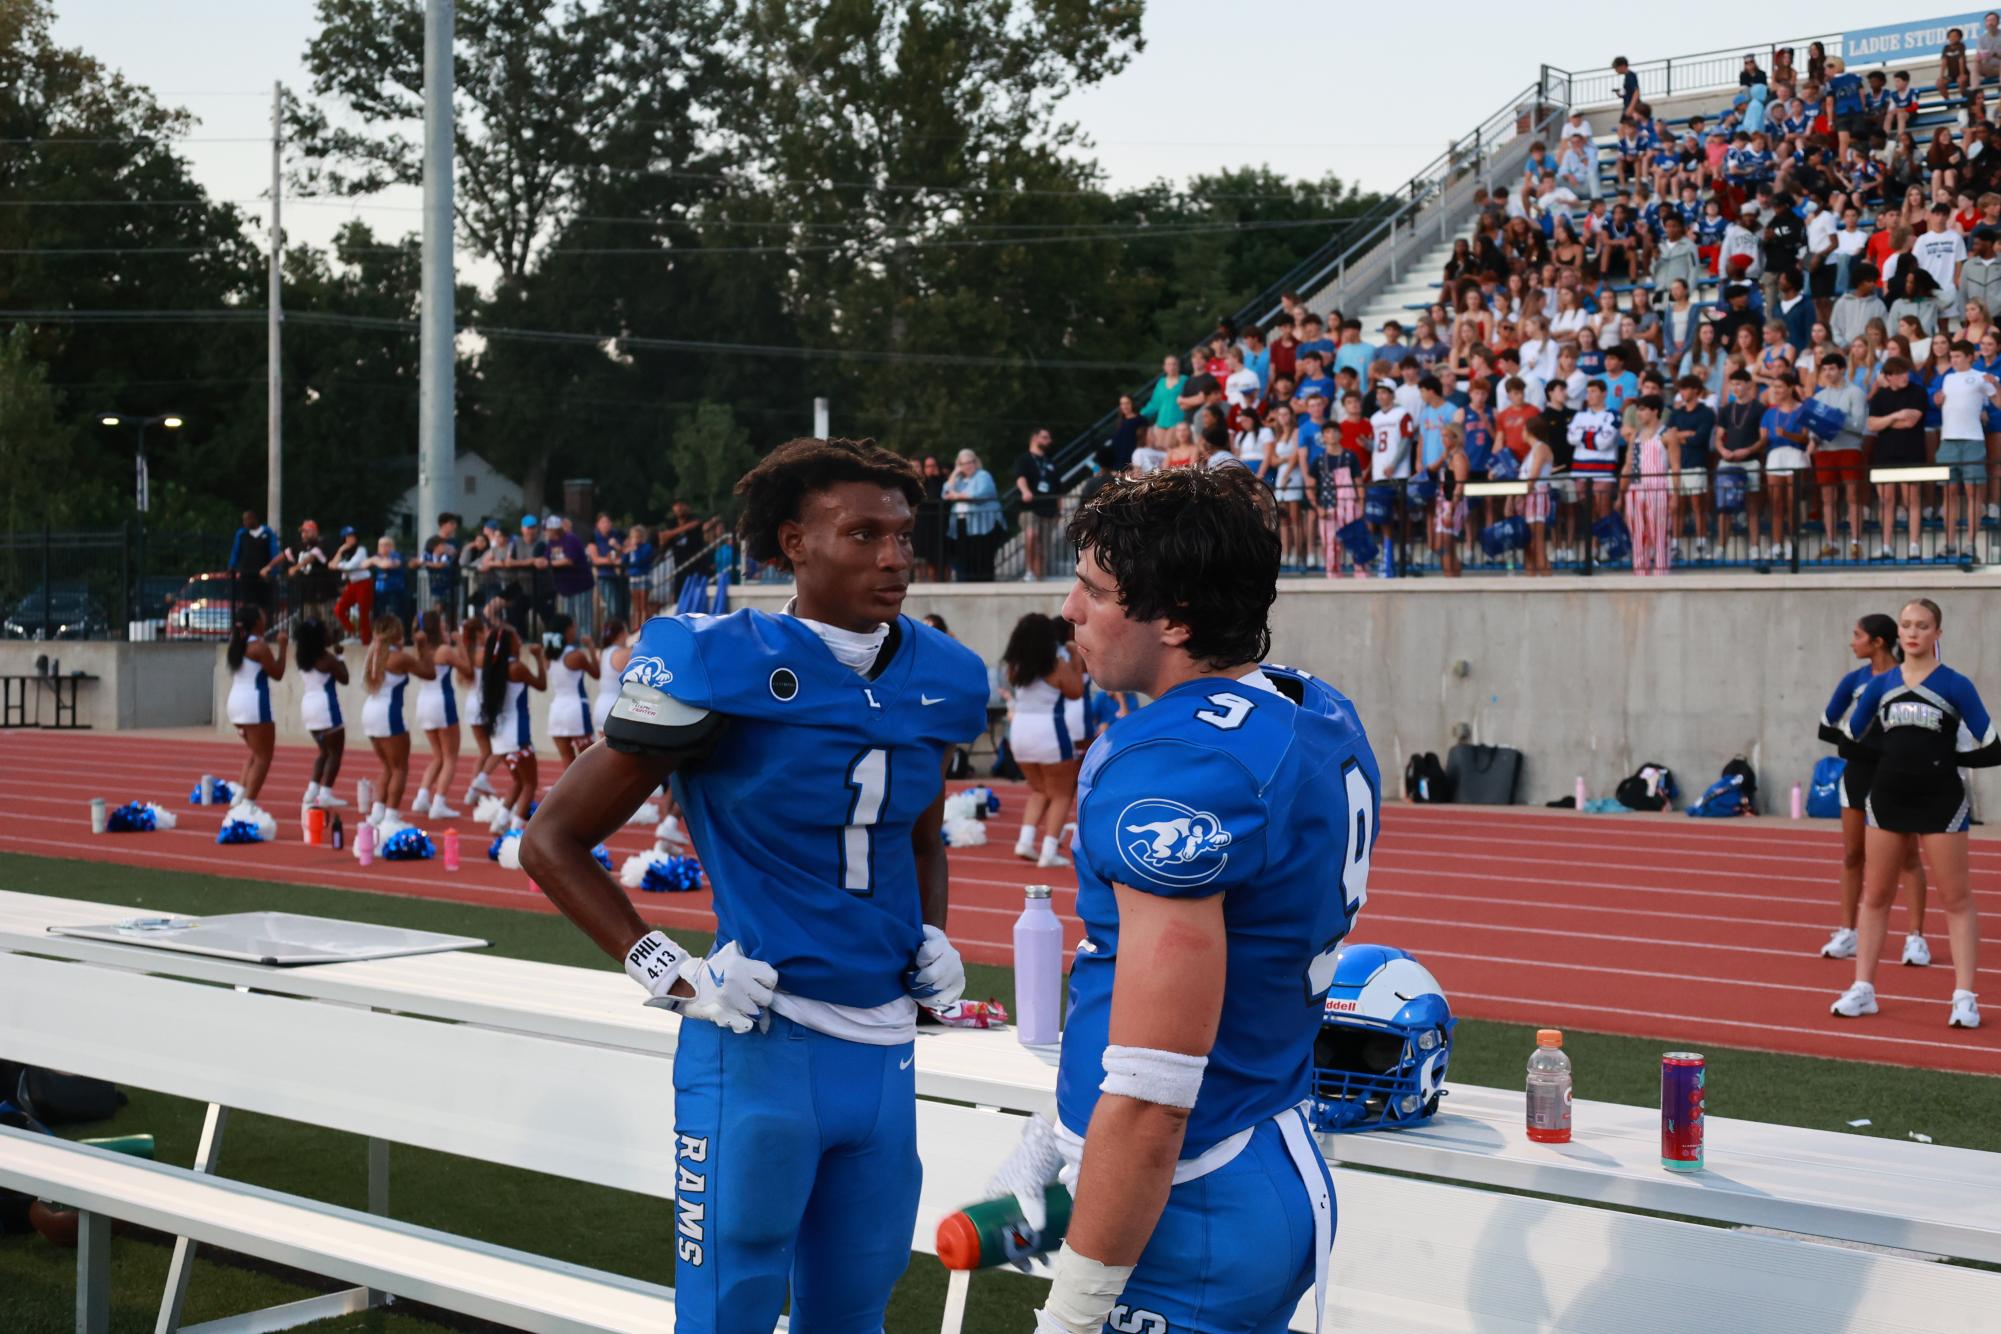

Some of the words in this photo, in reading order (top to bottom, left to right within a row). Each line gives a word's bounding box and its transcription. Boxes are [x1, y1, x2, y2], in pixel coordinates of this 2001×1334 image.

[1849, 33, 1900, 56] LADUE
[1904, 22, 1981, 49] STUDNT
[863, 688, 881, 708] L
[1195, 691, 1257, 731] 9
[839, 746, 890, 894] 1
[1304, 756, 1375, 1005] 9
[629, 936, 662, 967] PHIL
[647, 950, 676, 979] 4:13
[677, 1133, 708, 1268] RAMS
